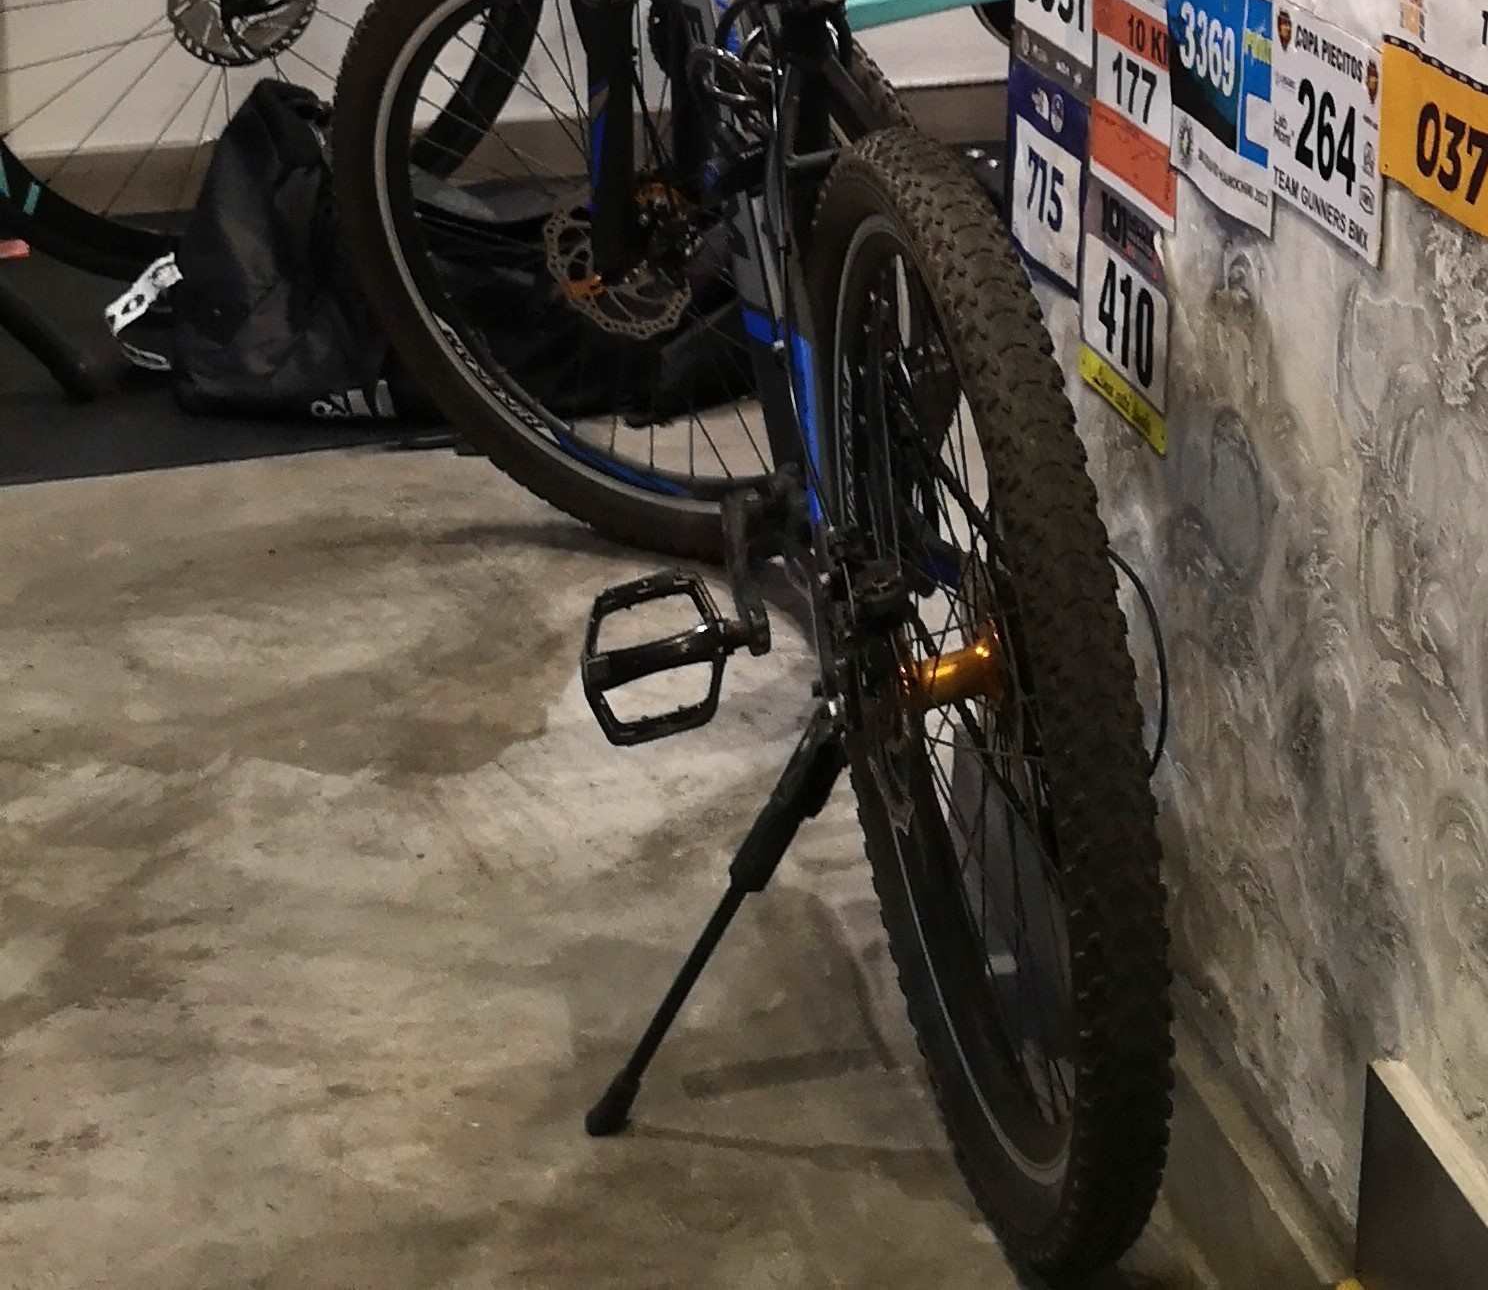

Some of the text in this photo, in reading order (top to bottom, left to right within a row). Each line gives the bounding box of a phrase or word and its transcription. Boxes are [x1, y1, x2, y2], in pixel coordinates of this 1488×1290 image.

[1112, 51, 1157, 126] 177
[1180, 1, 1235, 98] 3369
[1295, 23, 1364, 84] COPA PIECITOS
[1295, 78, 1358, 198] 264
[1026, 145, 1065, 233] 715
[1098, 258, 1155, 390] 410
